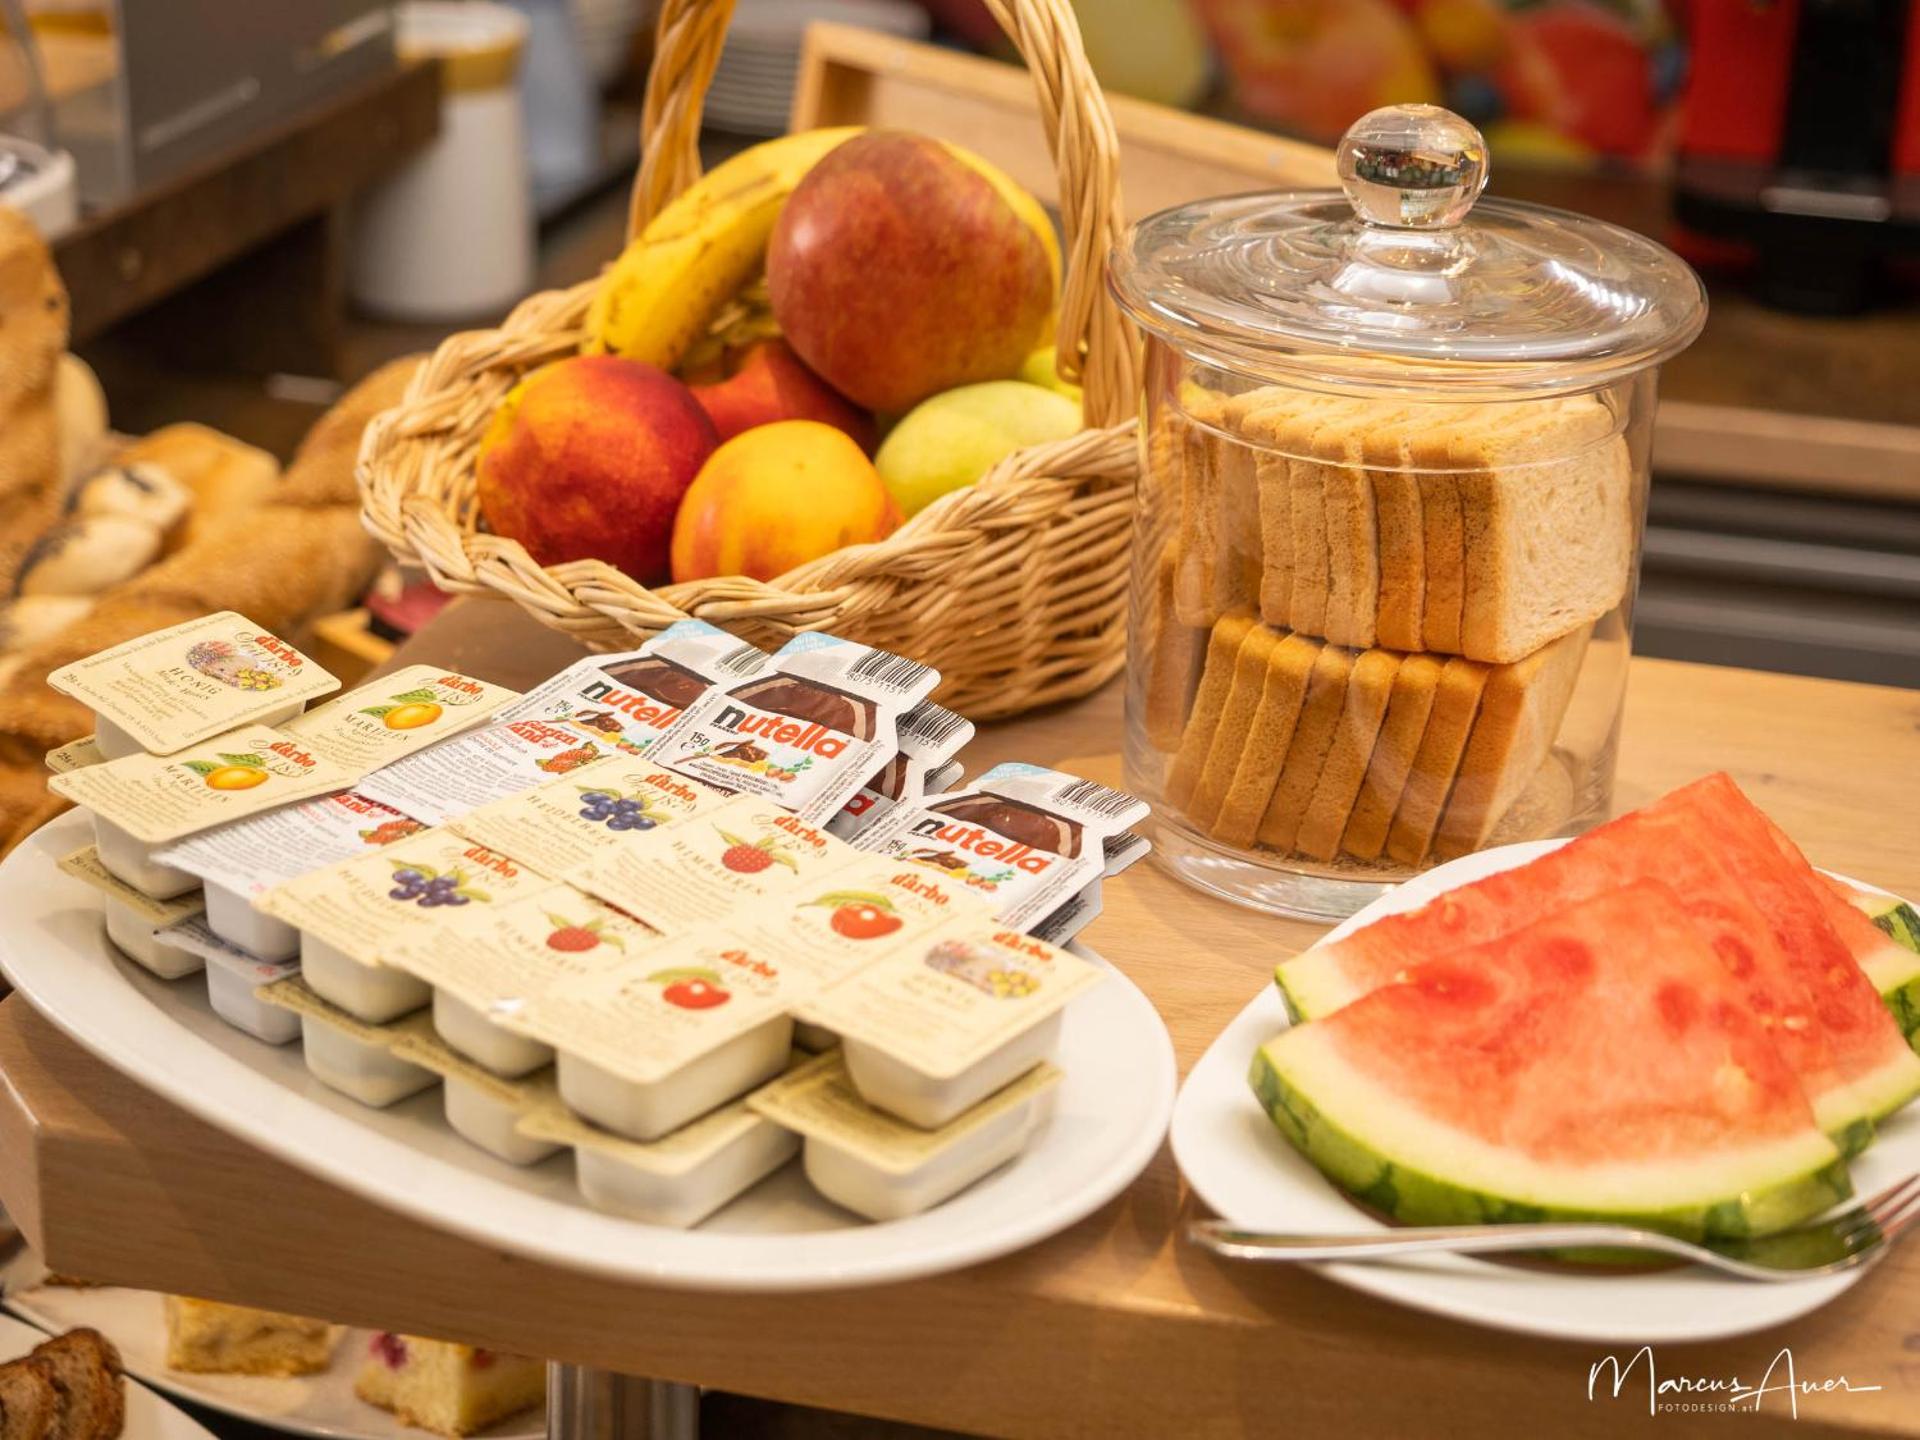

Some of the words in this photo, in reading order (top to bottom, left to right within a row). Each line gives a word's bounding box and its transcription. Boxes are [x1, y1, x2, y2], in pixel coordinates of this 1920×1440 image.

[168, 667, 222, 695] HONIG
[581, 680, 683, 730] nutell
[689, 731, 710, 747] 15g
[713, 704, 848, 759] nutella
[911, 818, 1052, 875] nutella
